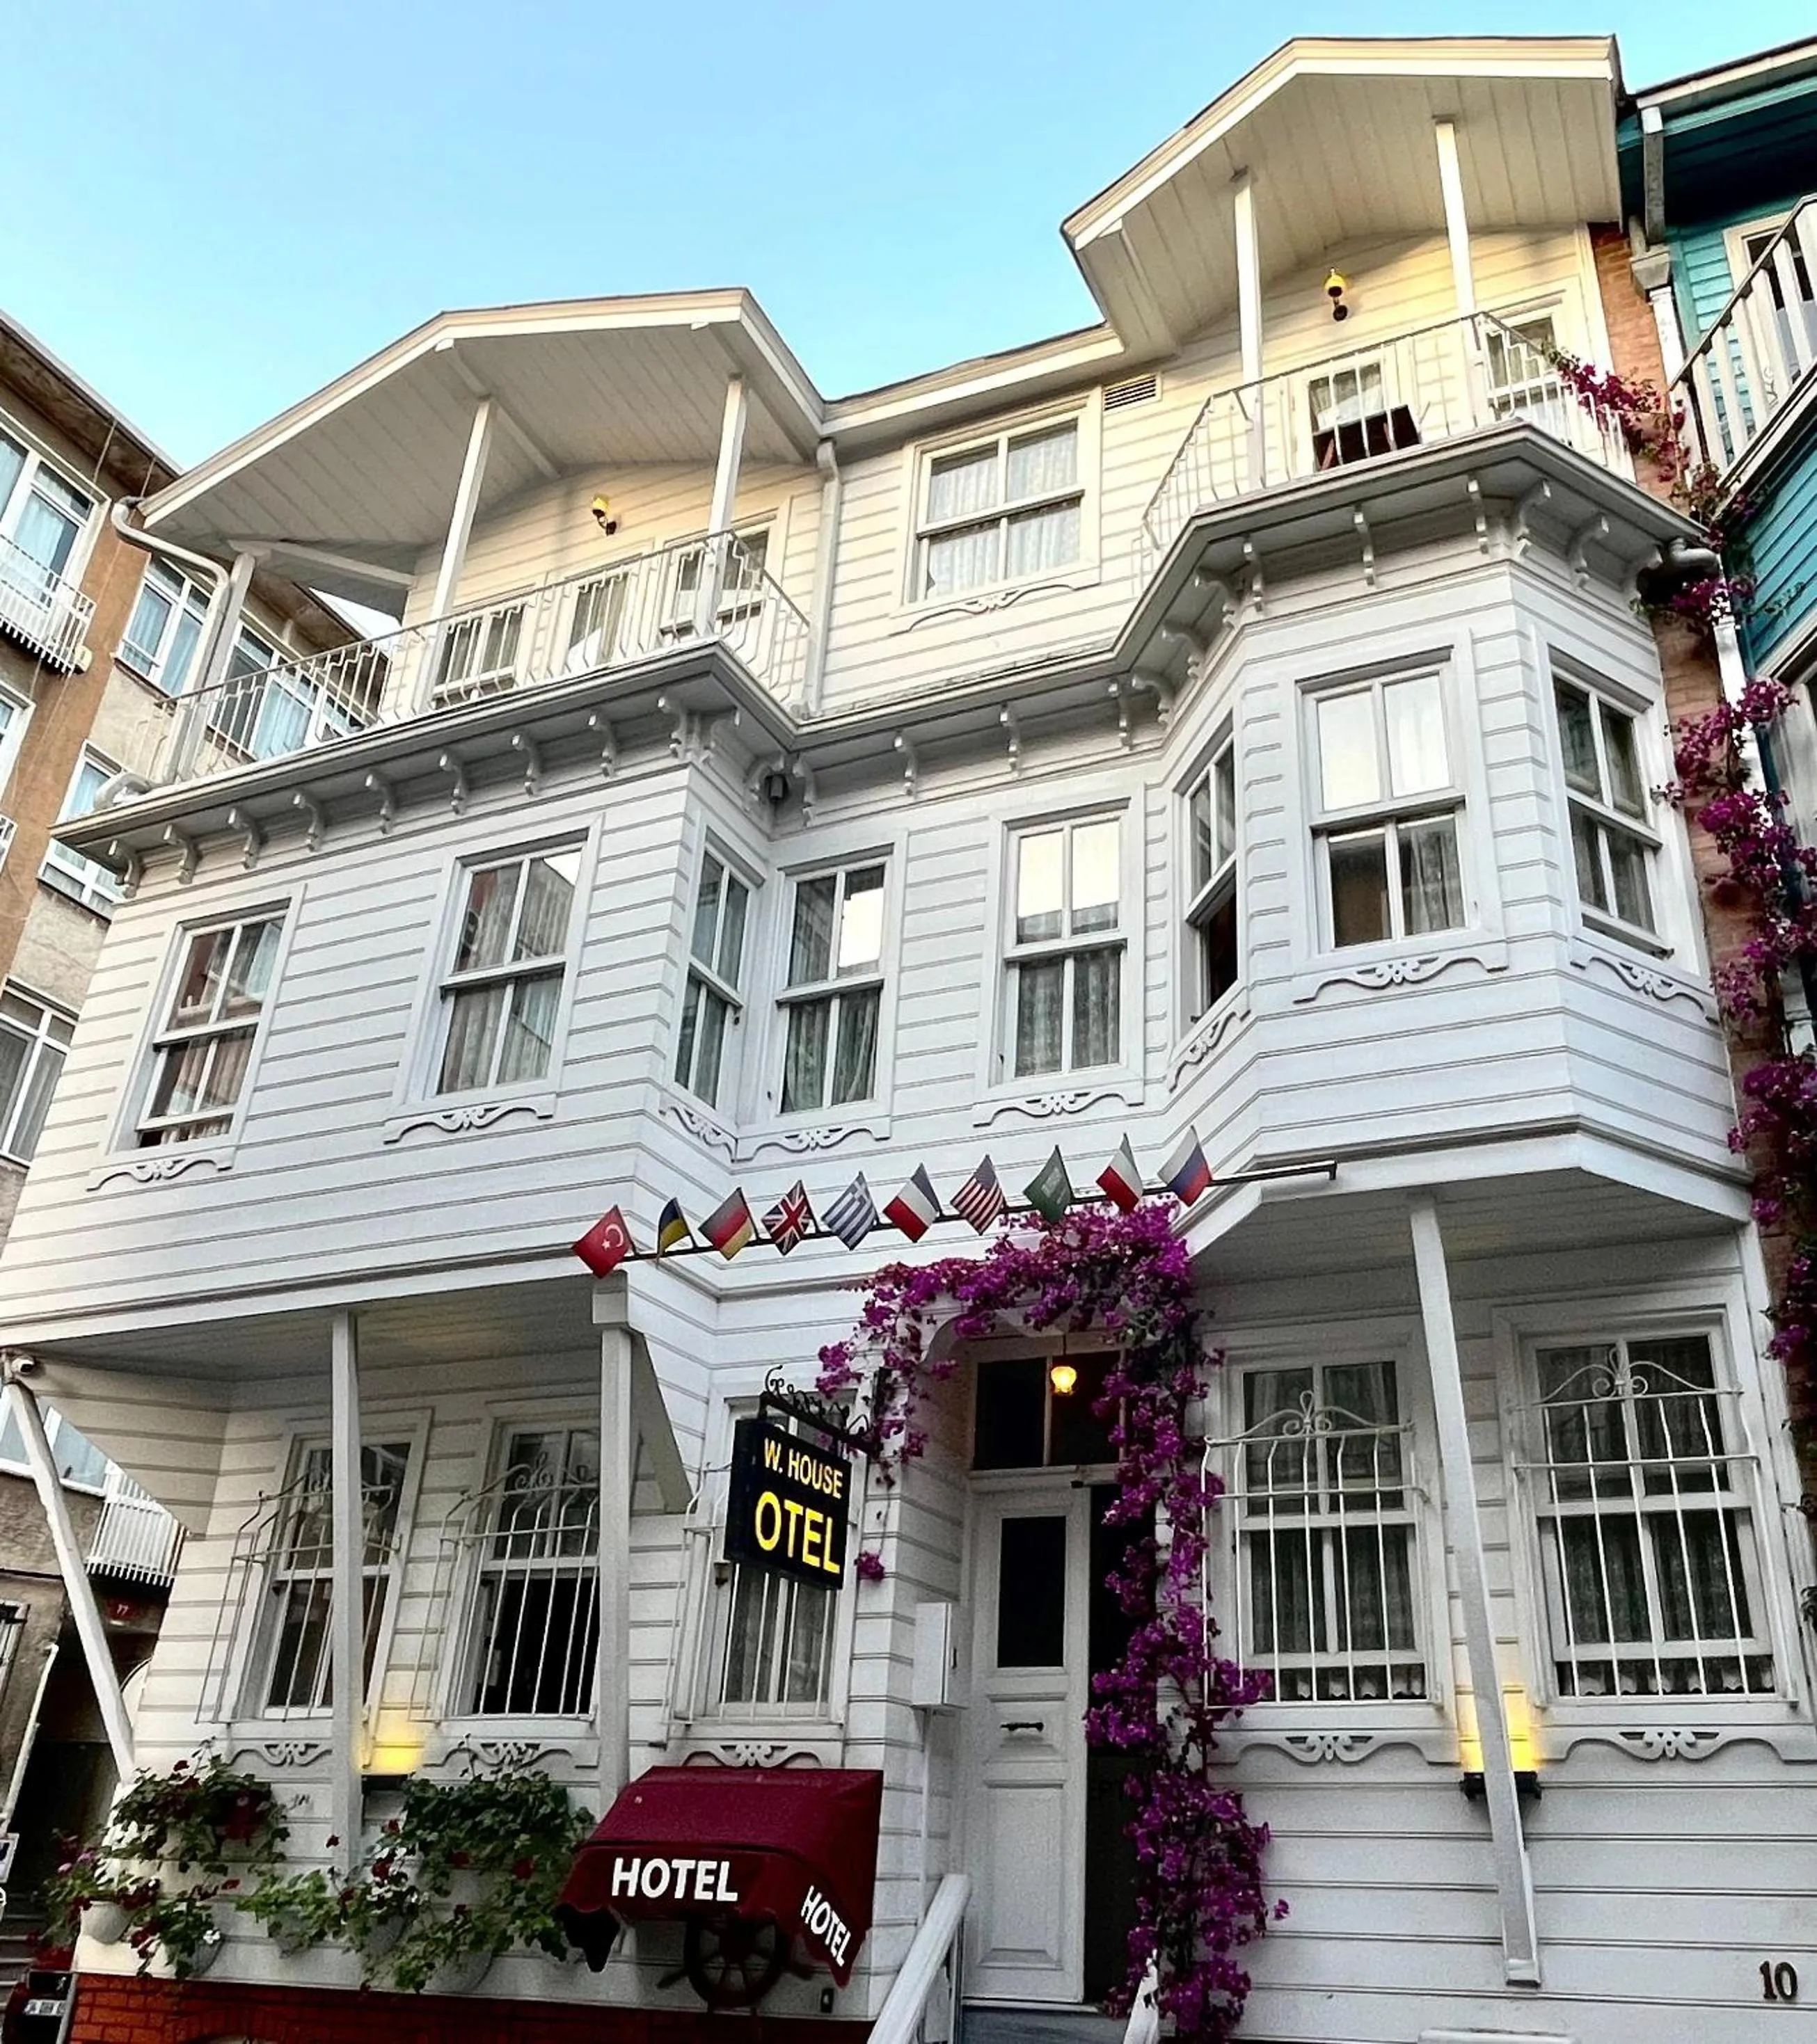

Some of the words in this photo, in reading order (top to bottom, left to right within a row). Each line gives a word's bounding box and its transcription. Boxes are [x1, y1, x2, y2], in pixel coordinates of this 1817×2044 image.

[764, 1437, 783, 1474] W.
[788, 1448, 843, 1499] HOUSE
[755, 1491, 841, 1574] OTEL
[612, 1858, 738, 1902] HOTEL
[801, 1885, 851, 1967] HOTEL
[1759, 1961, 1798, 1999] 10
